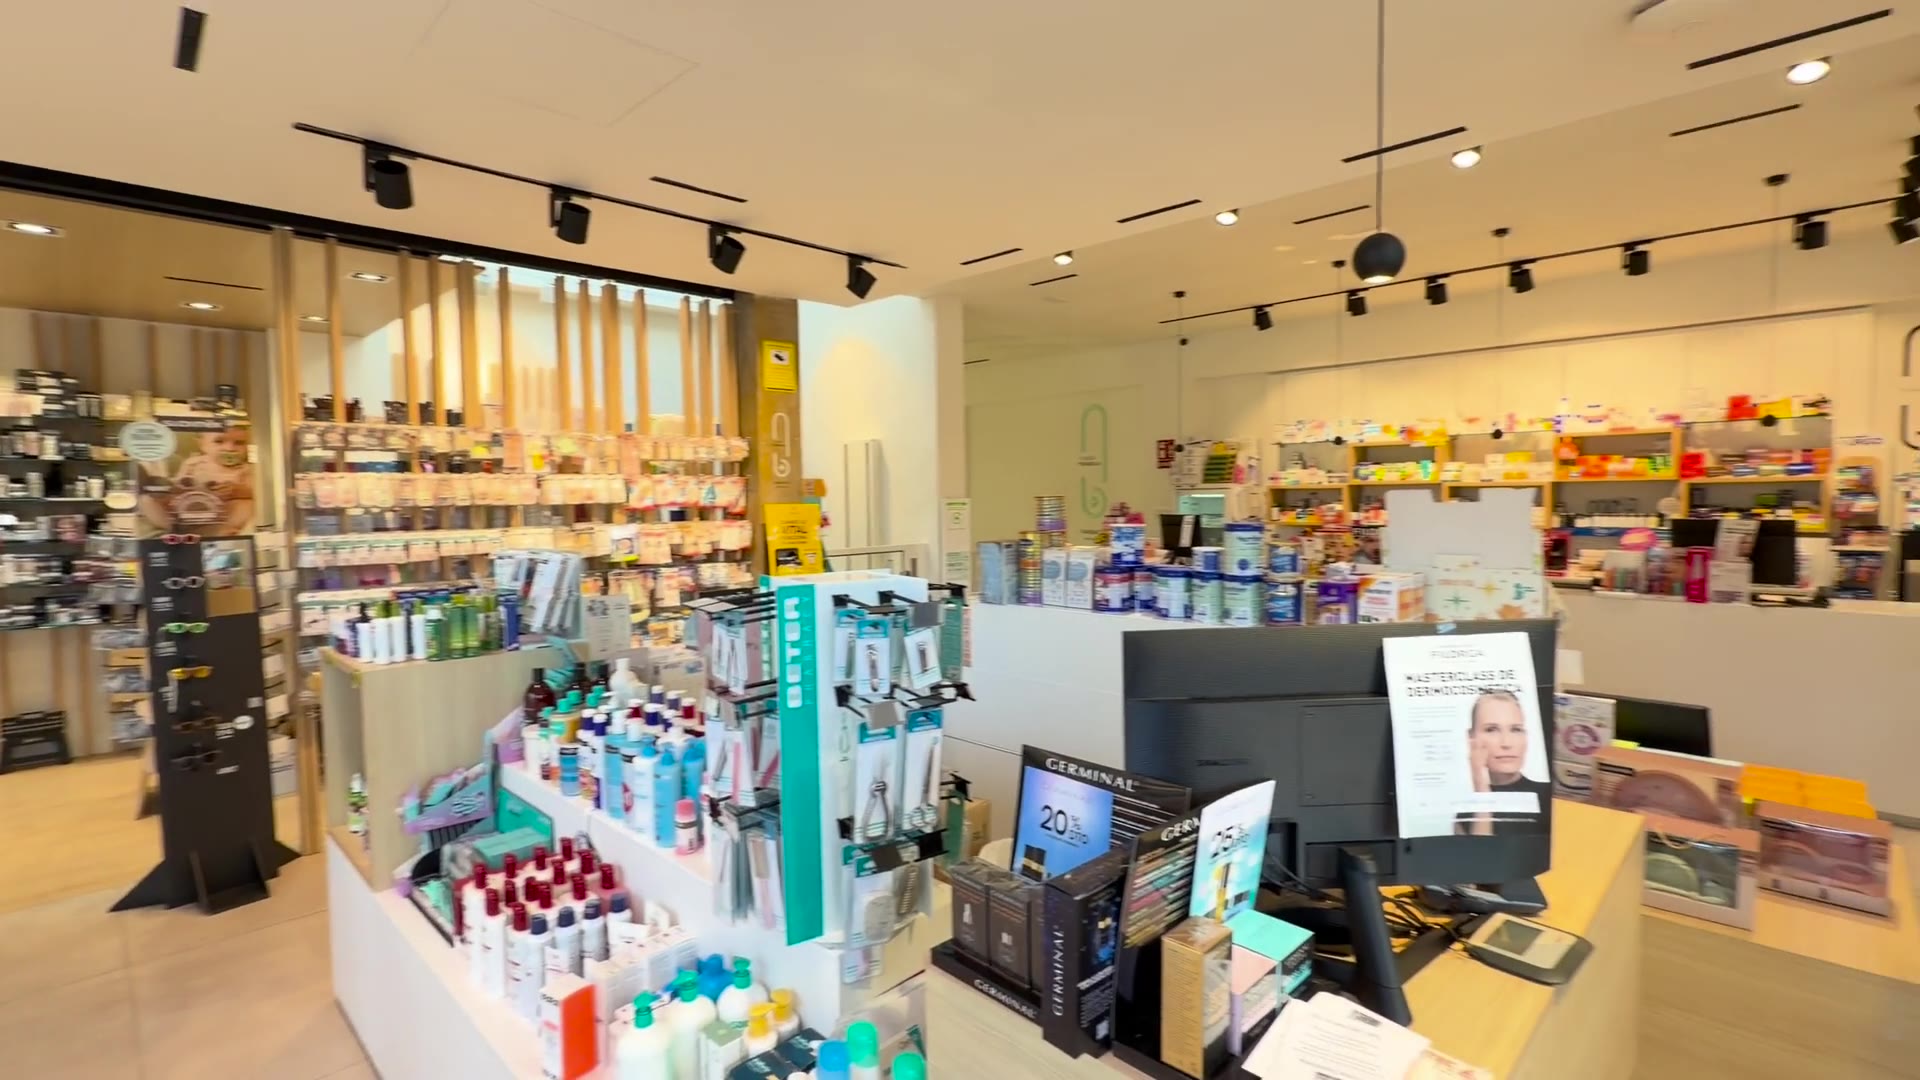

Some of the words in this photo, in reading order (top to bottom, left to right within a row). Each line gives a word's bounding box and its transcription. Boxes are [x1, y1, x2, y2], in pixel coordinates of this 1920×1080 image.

[1405, 670, 1495, 683] MASTERCLASS
[1498, 669, 1515, 680] DE
[1045, 757, 1136, 793] GERMINAL
[1040, 805, 1067, 835] 20
[1052, 924, 1064, 1017] GERMINAL
